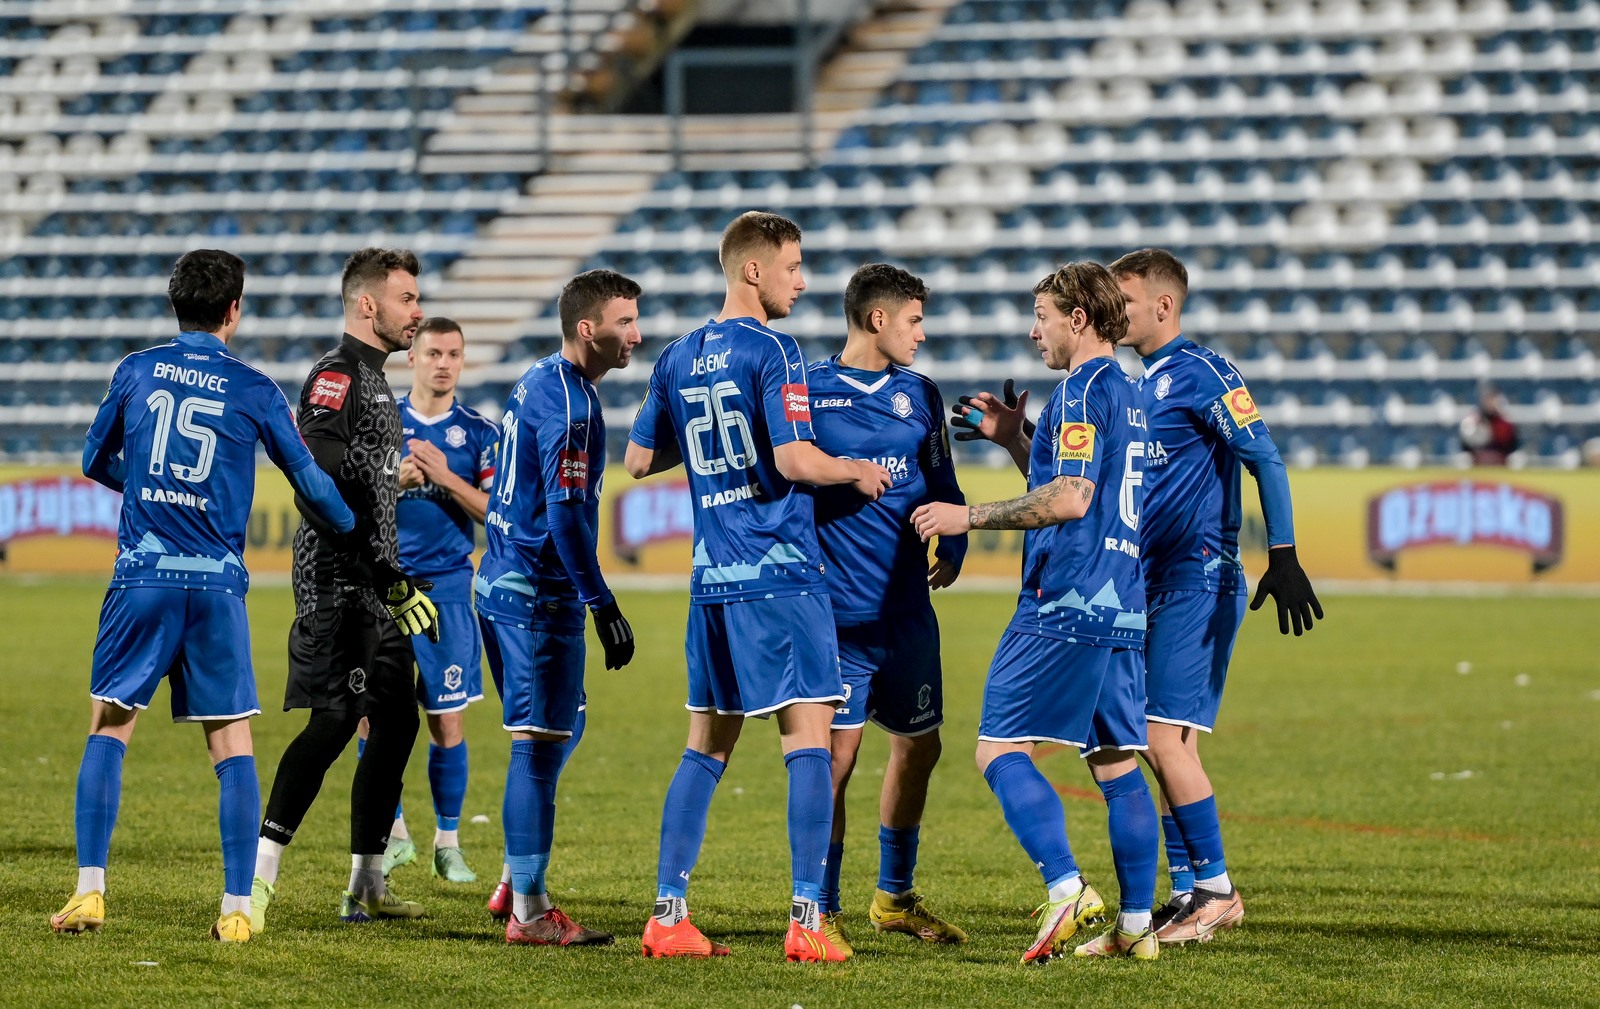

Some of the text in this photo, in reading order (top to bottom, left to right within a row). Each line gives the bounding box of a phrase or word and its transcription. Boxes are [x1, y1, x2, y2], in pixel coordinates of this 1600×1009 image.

[153, 362, 229, 394] BANOVEC
[315, 377, 346, 391] Super
[314, 386, 341, 400] Sport
[814, 398, 852, 408] LEGEA
[146, 389, 225, 483] 15
[678, 380, 758, 476] 26
[141, 487, 208, 512] RADNIK
[701, 482, 762, 508] RADNIK
[909, 709, 935, 724] LEGEA
